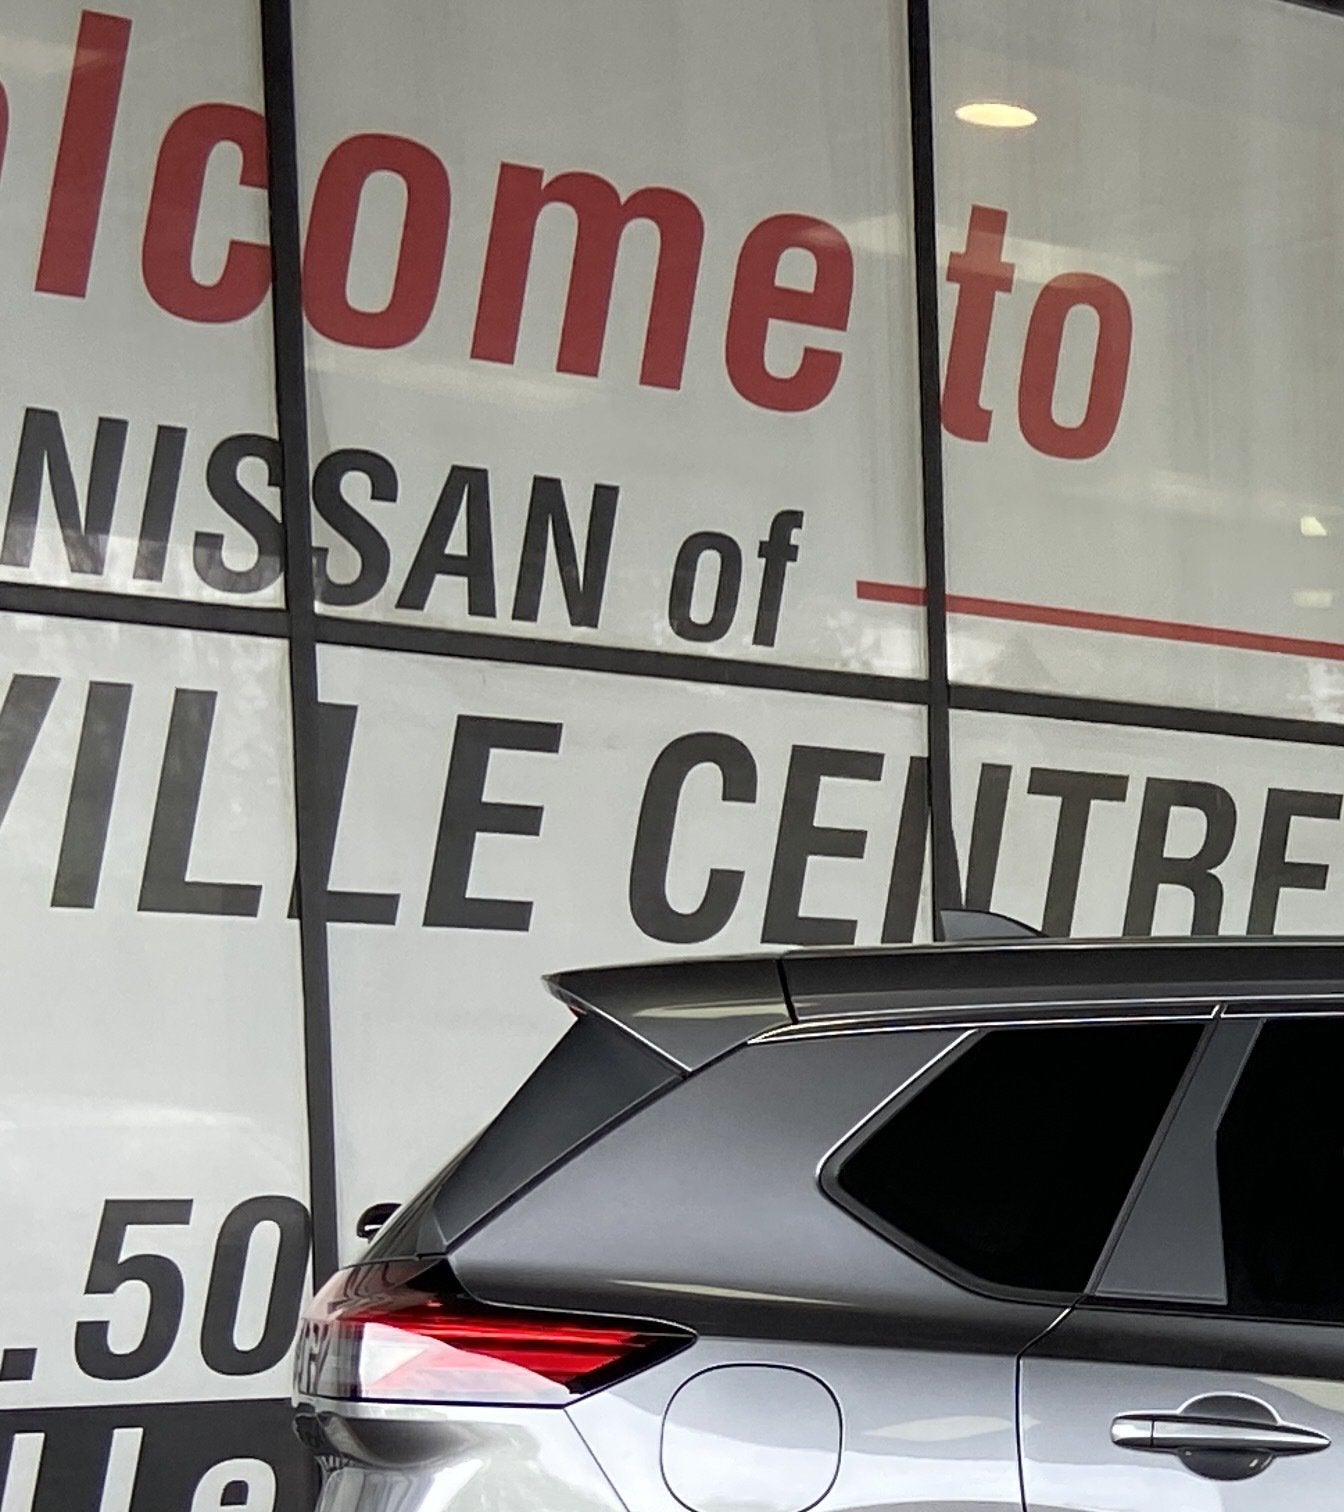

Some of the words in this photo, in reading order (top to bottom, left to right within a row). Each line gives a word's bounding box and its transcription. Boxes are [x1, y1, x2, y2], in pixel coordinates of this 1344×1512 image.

[0, 10, 855, 413] lcome
[940, 206, 1133, 460] to
[0, 408, 619, 629] NISSAN
[667, 511, 804, 648] of
